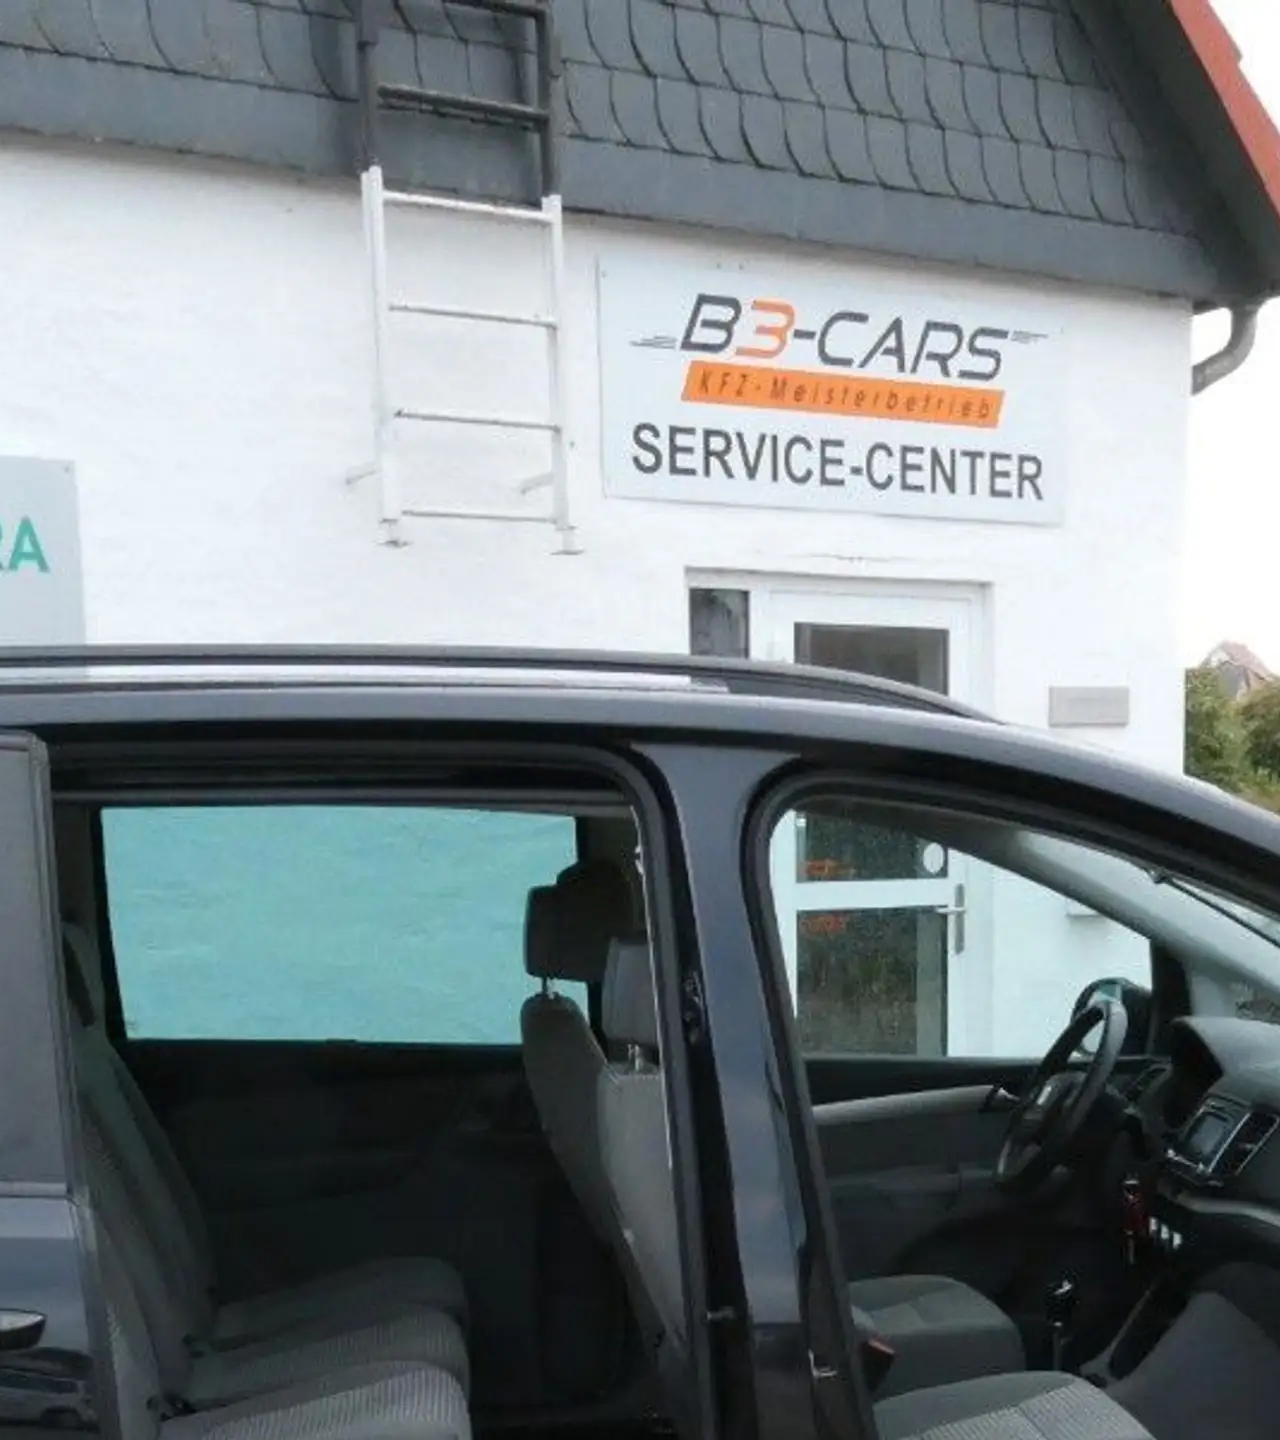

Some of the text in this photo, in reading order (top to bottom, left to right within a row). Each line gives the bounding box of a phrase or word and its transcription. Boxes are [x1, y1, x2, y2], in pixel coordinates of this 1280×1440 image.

[680, 293, 1010, 381] B3-CARS
[699, 367, 995, 420] KFZ-Meisterbetrieb
[632, 422, 1044, 500] SERVICE-CENTER
